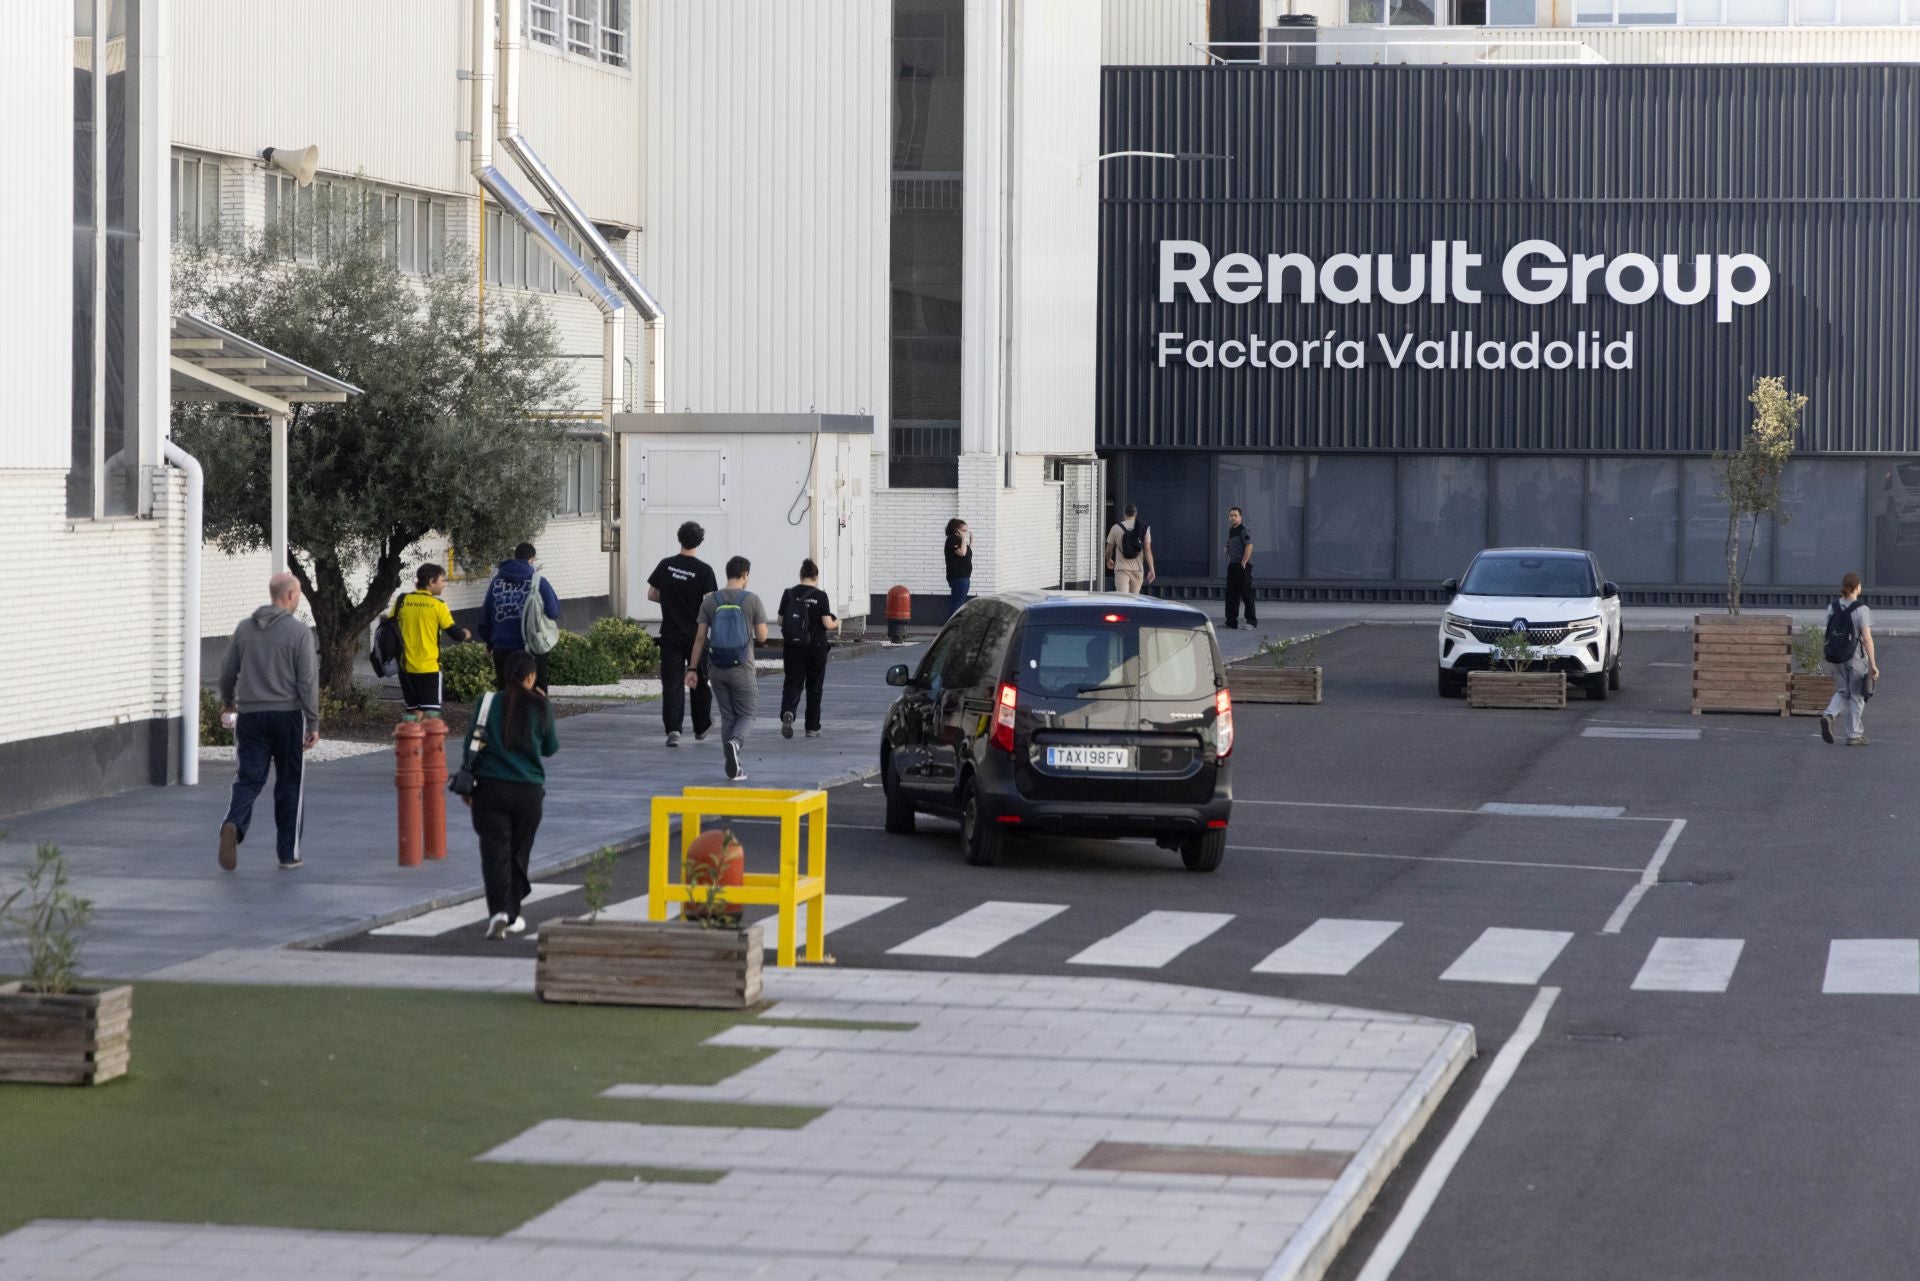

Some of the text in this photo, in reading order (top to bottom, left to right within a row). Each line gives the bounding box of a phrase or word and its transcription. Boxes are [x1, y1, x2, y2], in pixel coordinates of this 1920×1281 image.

[1160, 240, 1770, 322] Renault Group
[1159, 331, 1633, 369] Factoría Valladolid
